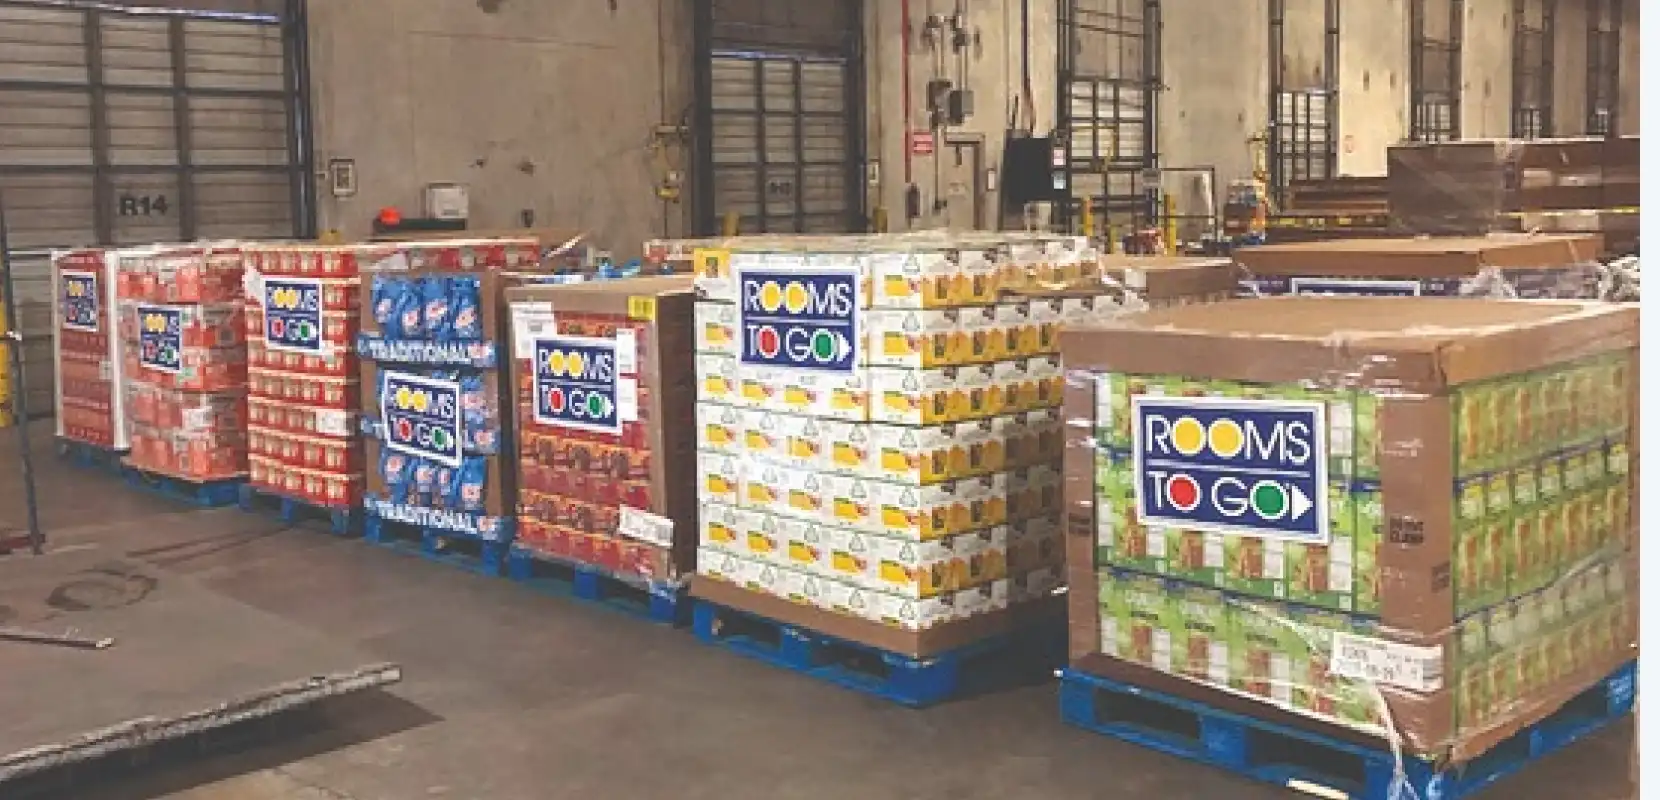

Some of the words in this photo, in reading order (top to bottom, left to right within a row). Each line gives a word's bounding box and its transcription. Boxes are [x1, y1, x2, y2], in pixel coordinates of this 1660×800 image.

[120, 194, 168, 216] R14
[744, 279, 852, 317] ROOMS
[369, 339, 472, 365] TRADITIONAL
[747, 324, 780, 359] TO
[785, 326, 836, 363] GO
[539, 347, 613, 383] ROOMS
[386, 383, 454, 419] ROOMS
[540, 384, 567, 415] TO
[569, 388, 604, 419] GO
[389, 415, 412, 442] TO
[415, 422, 447, 451] GO
[1146, 414, 1311, 465] ROOMS
[1146, 470, 1201, 512] TO
[1211, 476, 1290, 520] GO
[375, 499, 478, 535] TRADITIONAL
